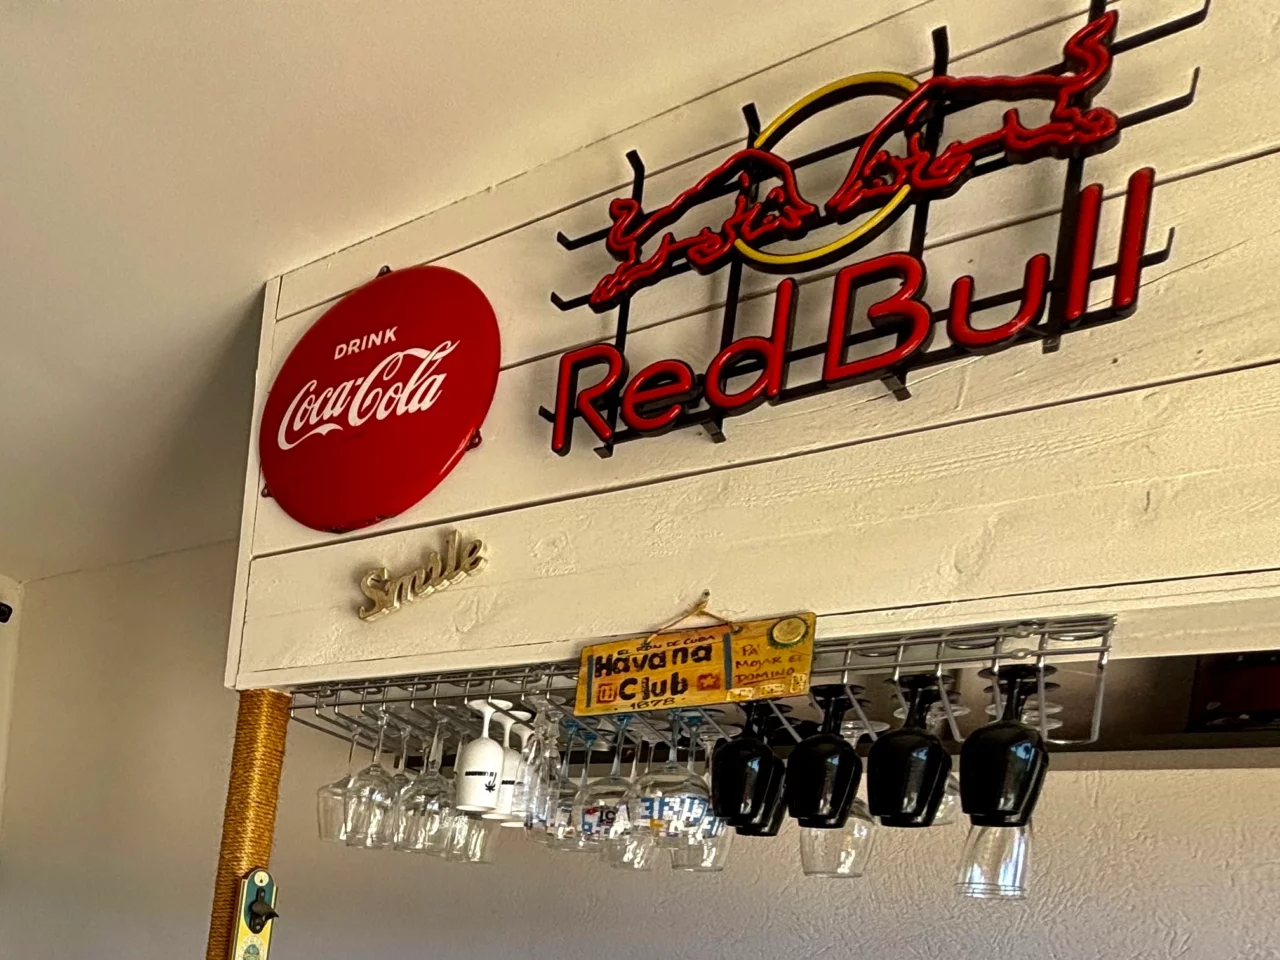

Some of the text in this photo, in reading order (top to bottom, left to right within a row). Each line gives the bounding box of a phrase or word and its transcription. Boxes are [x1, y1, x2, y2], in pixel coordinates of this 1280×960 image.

[552, 167, 1156, 456] Red Bull
[334, 326, 398, 361] DRINK
[277, 340, 460, 451] Coca-Cola
[358, 529, 490, 621] Smile
[594, 644, 713, 678] Havana
[735, 667, 796, 684] DOMINO
[618, 672, 689, 701] Club
[629, 697, 675, 710] 1878
